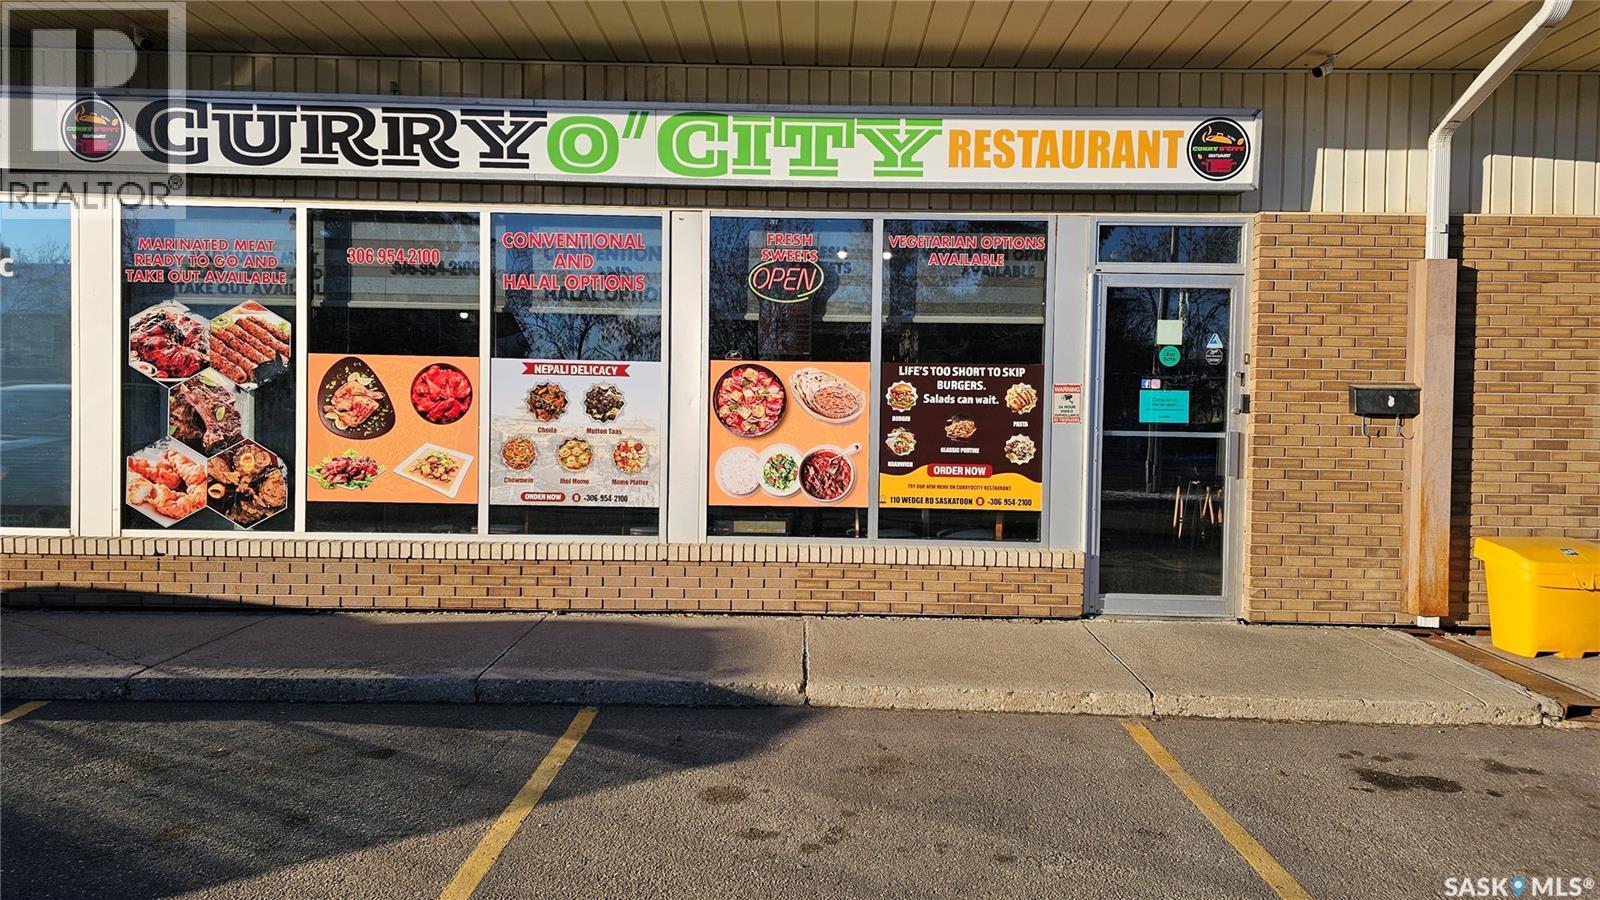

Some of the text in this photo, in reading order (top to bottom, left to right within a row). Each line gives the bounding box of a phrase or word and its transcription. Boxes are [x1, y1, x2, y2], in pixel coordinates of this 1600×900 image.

[136, 99, 547, 168] CURRY
[656, 111, 944, 178] CITY
[948, 129, 1186, 169] RESTAURANT
[138, 237, 276, 252] MARINATED MEAT
[501, 232, 646, 250] CONVENTIONAL
[767, 232, 814, 246] FRESH
[888, 234, 1046, 250] VEGETARIAN OPTIONS
[134, 253, 280, 269] READY TO GO AND
[346, 247, 441, 266] 306-954-2100
[552, 253, 595, 270] AND
[761, 248, 819, 263] SWEETS
[928, 252, 1005, 267] AVAILABLE
[125, 269, 288, 285] TAKE OUT AVAILABLE
[501, 273, 646, 292] HALAL OPTIONS
[753, 267, 818, 291] OPEN
[534, 364, 618, 376] NEPALI DELICACY
[899, 366, 1026, 378] LIFE'S TOO SHORT TO SKIP
[937, 380, 986, 391] BURGERS.
[923, 394, 1000, 406] Salads can wait.
[586, 427, 607, 435] Mutton
[933, 465, 987, 476] ORDER NOW
[890, 496, 900, 504] 110
[902, 496, 924, 504] WEDGE
[935, 497, 973, 505] SASKATOON
